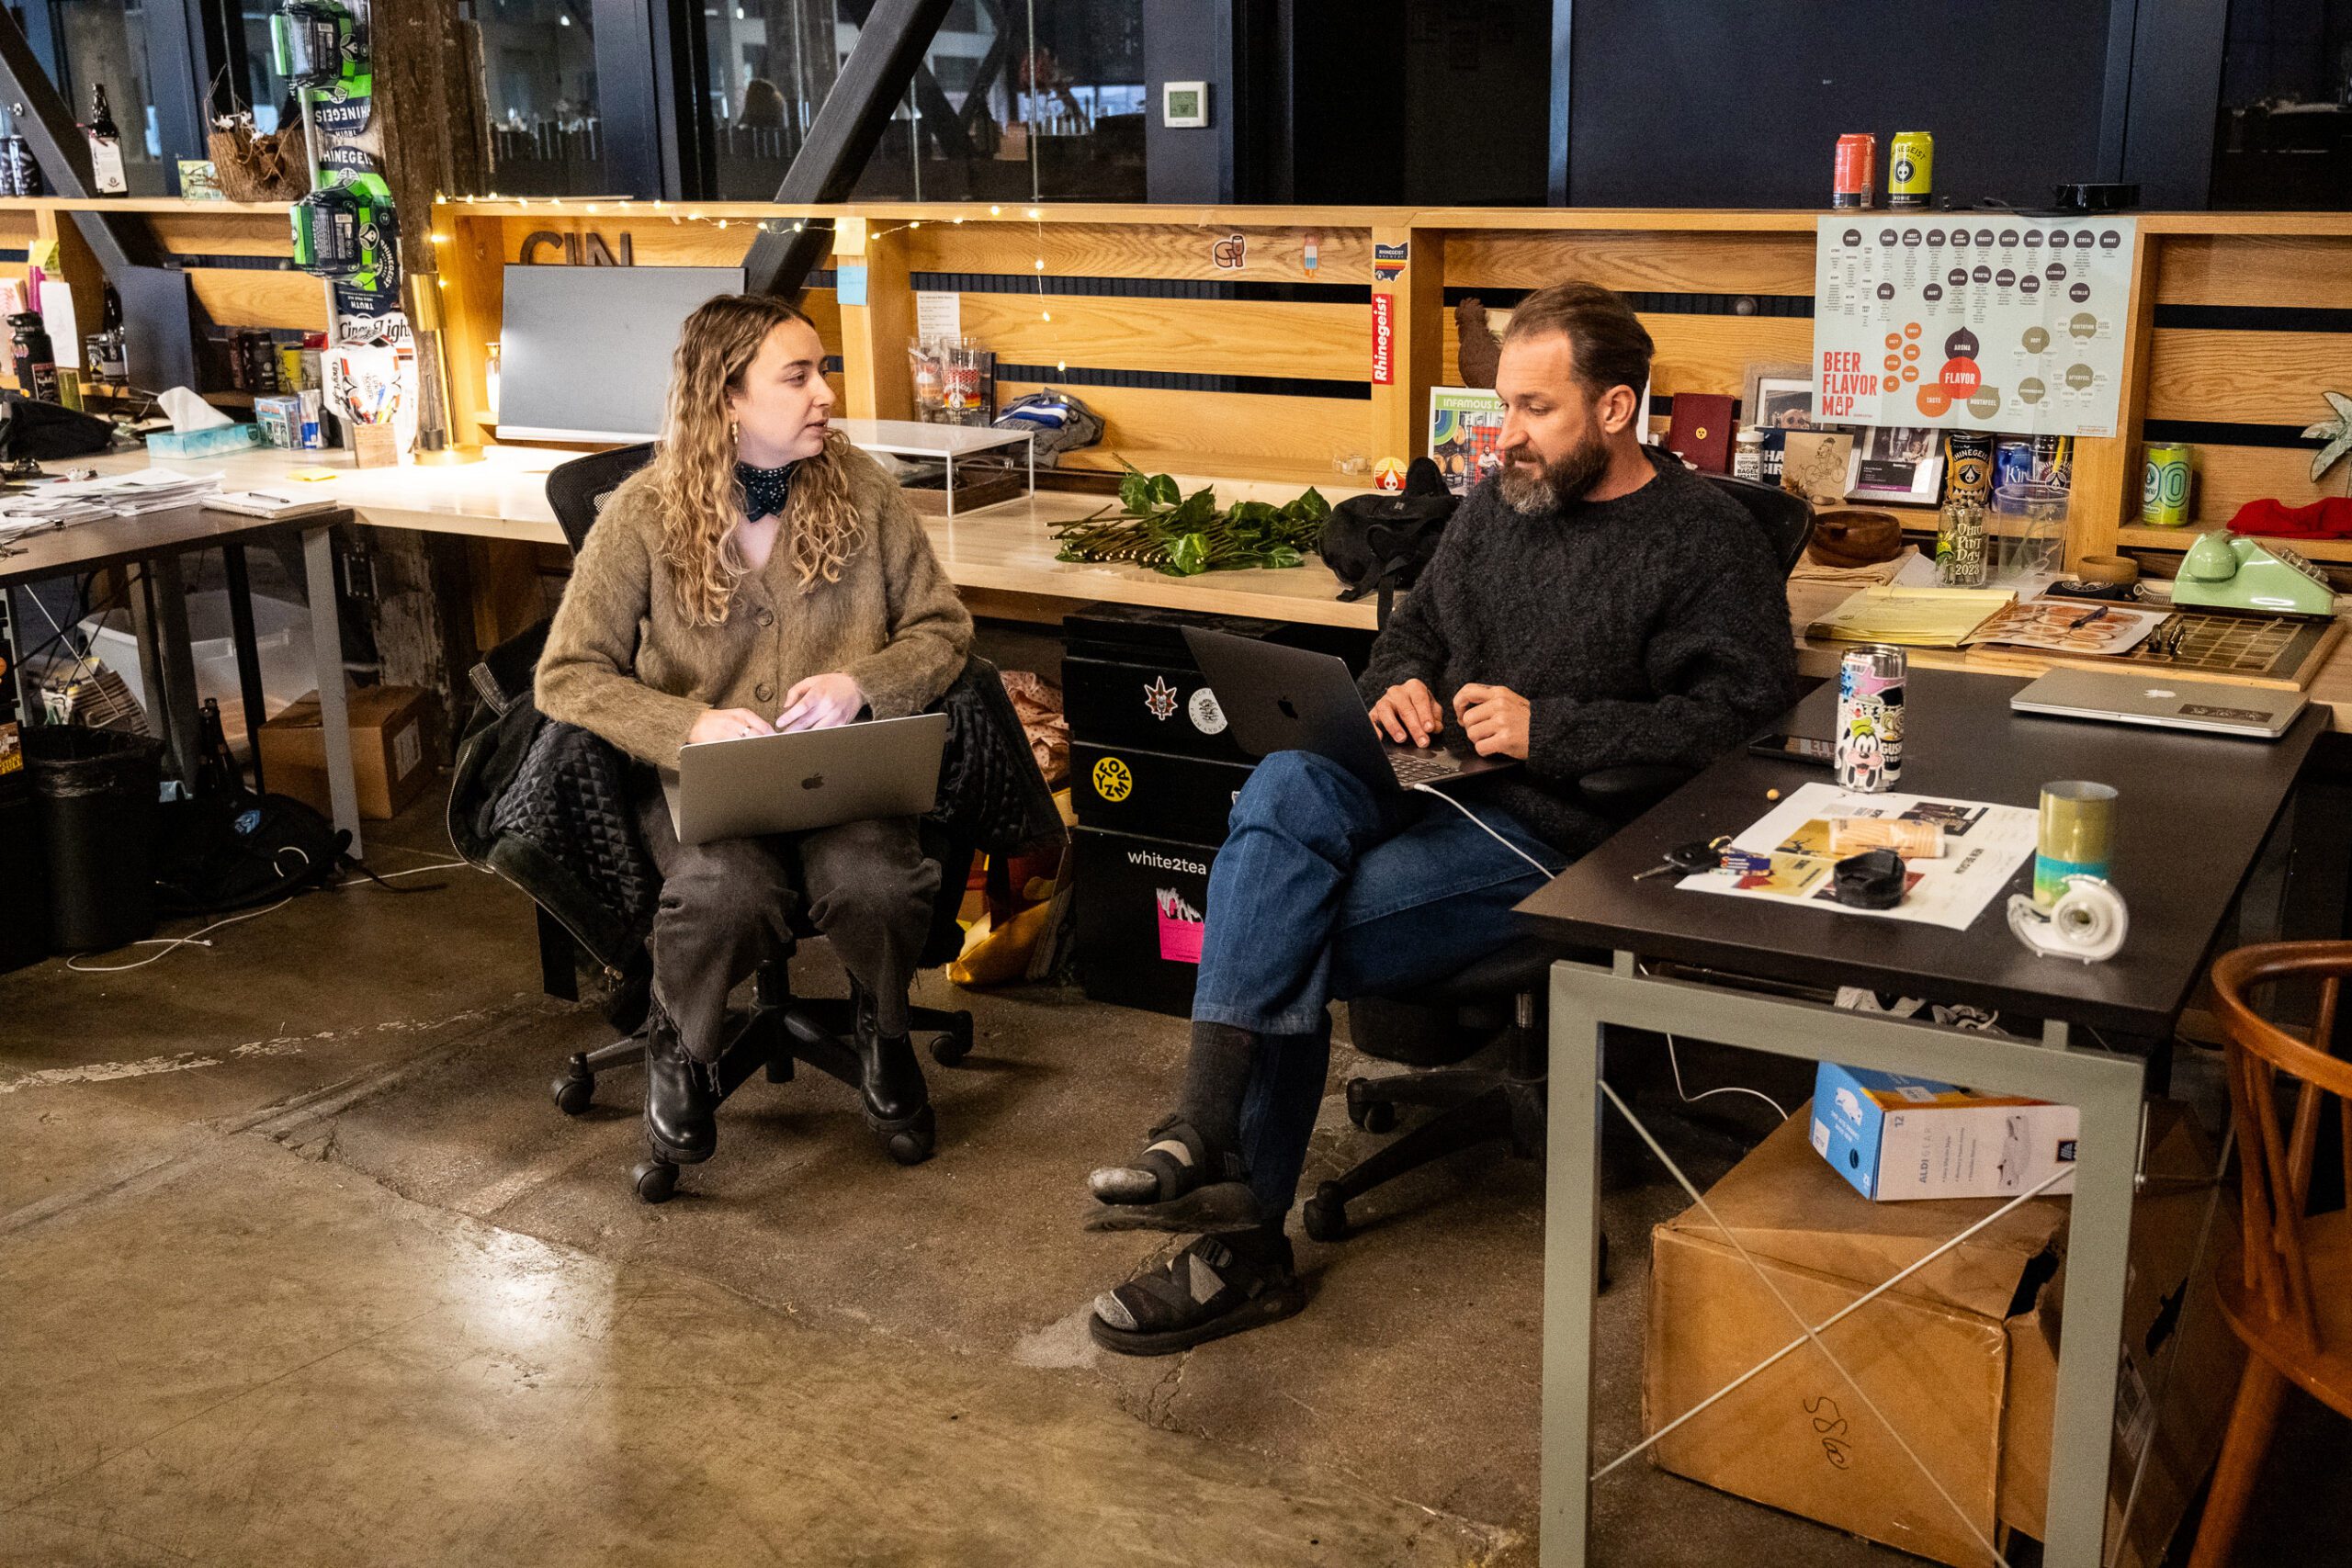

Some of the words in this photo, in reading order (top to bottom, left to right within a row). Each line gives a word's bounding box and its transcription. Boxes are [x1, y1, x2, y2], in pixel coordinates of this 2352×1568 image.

[315, 105, 371, 122] HINEGEIS
[520, 231, 634, 266] CIN
[351, 301, 374, 310] TRUTH
[1374, 297, 1391, 382] Rhinegeist
[1824, 351, 1860, 372] BEER
[1823, 374, 1878, 396] FLAVOR
[1944, 372, 1975, 385] FLAVOR
[1443, 397, 1492, 410] INFAMOUS
[1822, 396, 1854, 416] MAP
[1953, 448, 1989, 461] HINEGEIS
[1955, 564, 1980, 576] 2023
[1127, 850, 1207, 875] white2tea
[1894, 1115, 1905, 1128] 12
[1918, 1158, 1930, 1184] ALDI
